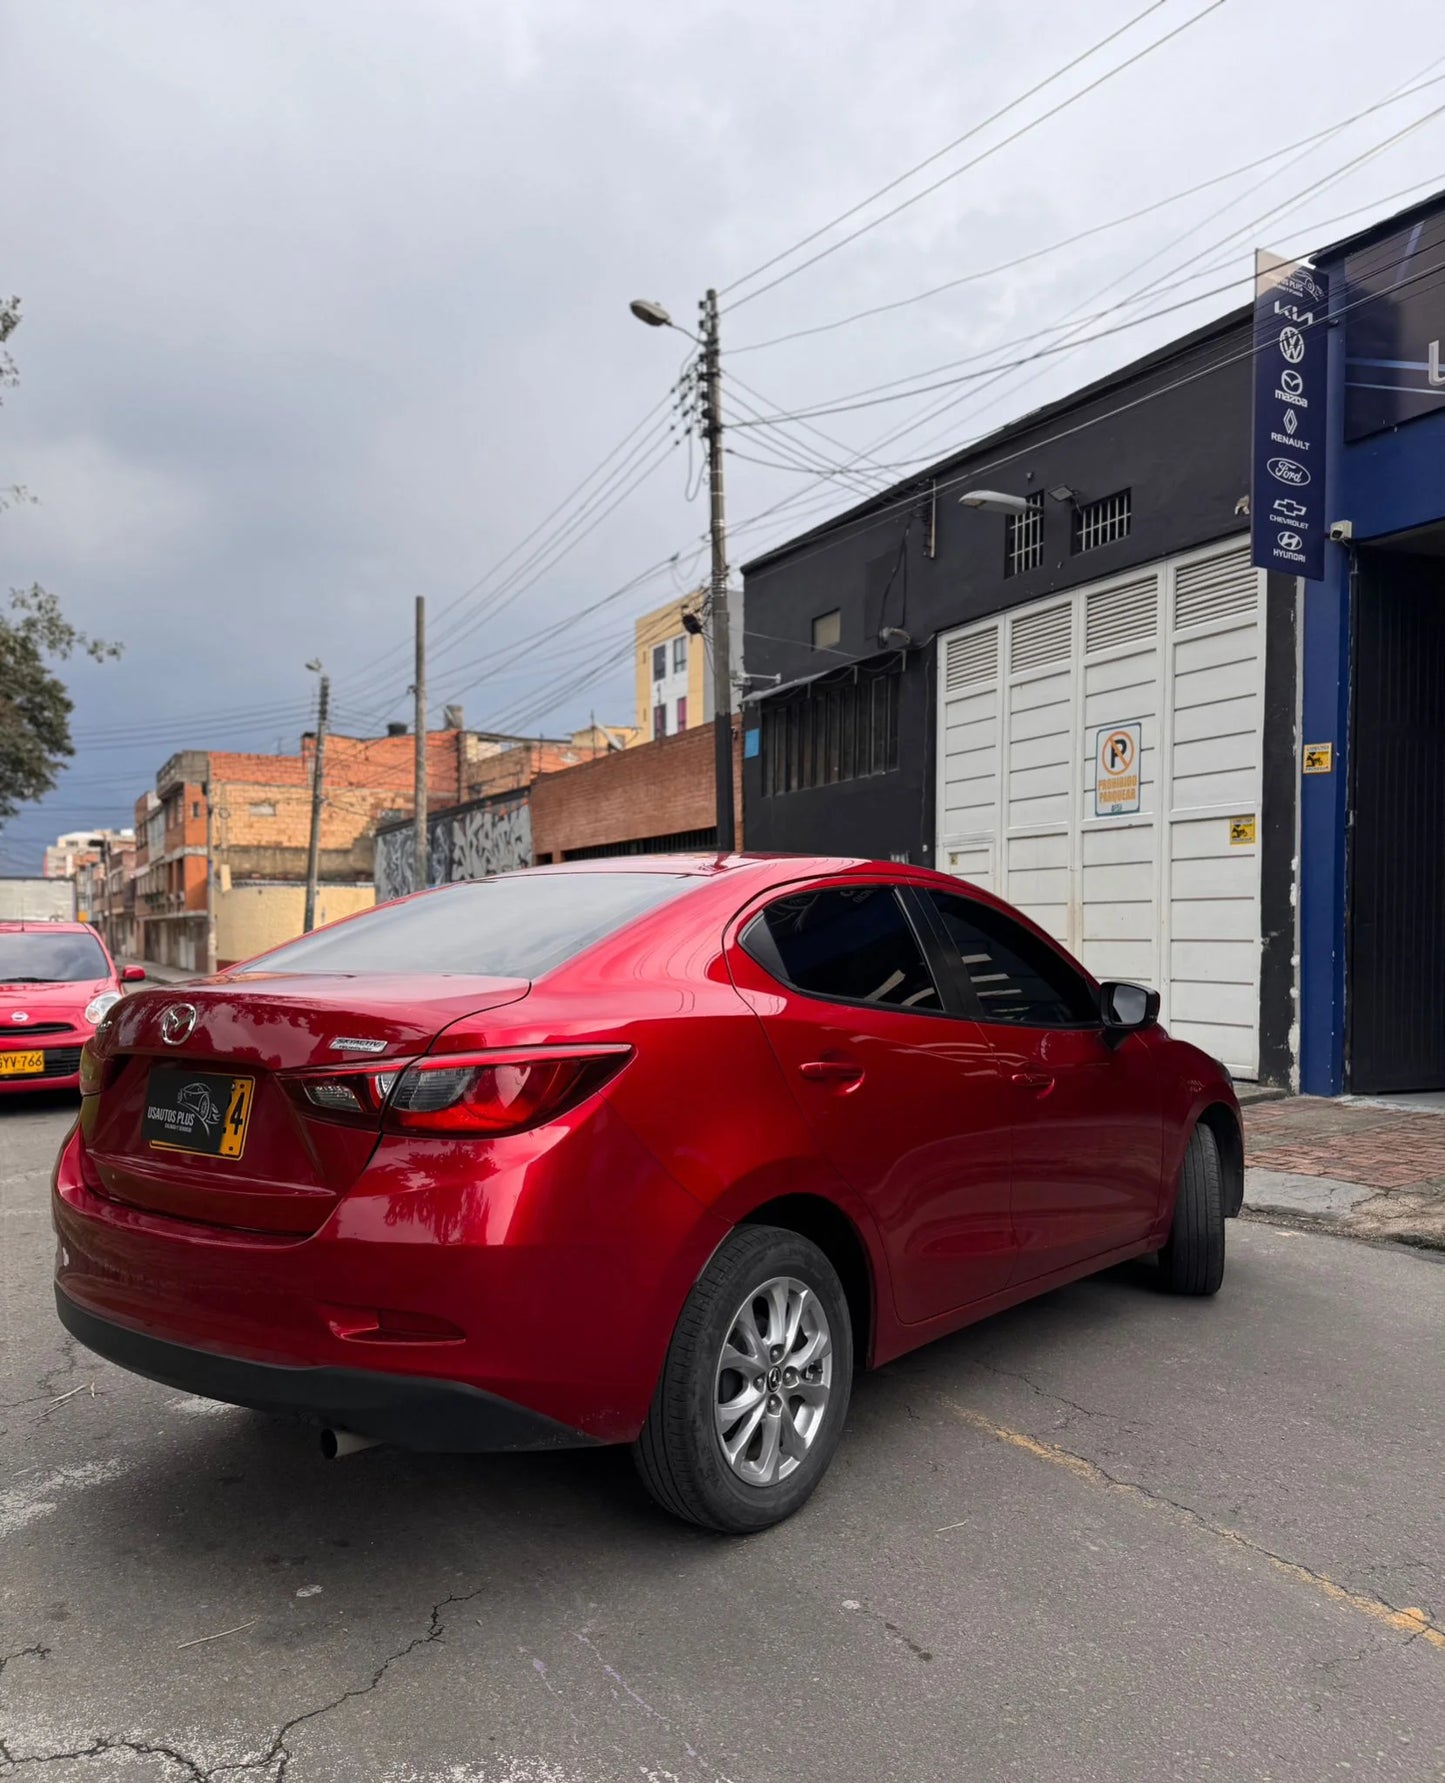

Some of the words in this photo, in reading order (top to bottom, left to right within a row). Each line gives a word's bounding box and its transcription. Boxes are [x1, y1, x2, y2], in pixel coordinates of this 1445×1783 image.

[1275, 389, 1308, 408] mazda
[1271, 432, 1310, 450] RENAULT
[1275, 461, 1303, 482] Ford
[1269, 514, 1309, 530] CHEVROLET
[1273, 548, 1306, 563] HYUNDAI
[147, 1105, 177, 1123] USAUTOS
[177, 1111, 195, 1126] PLUS
